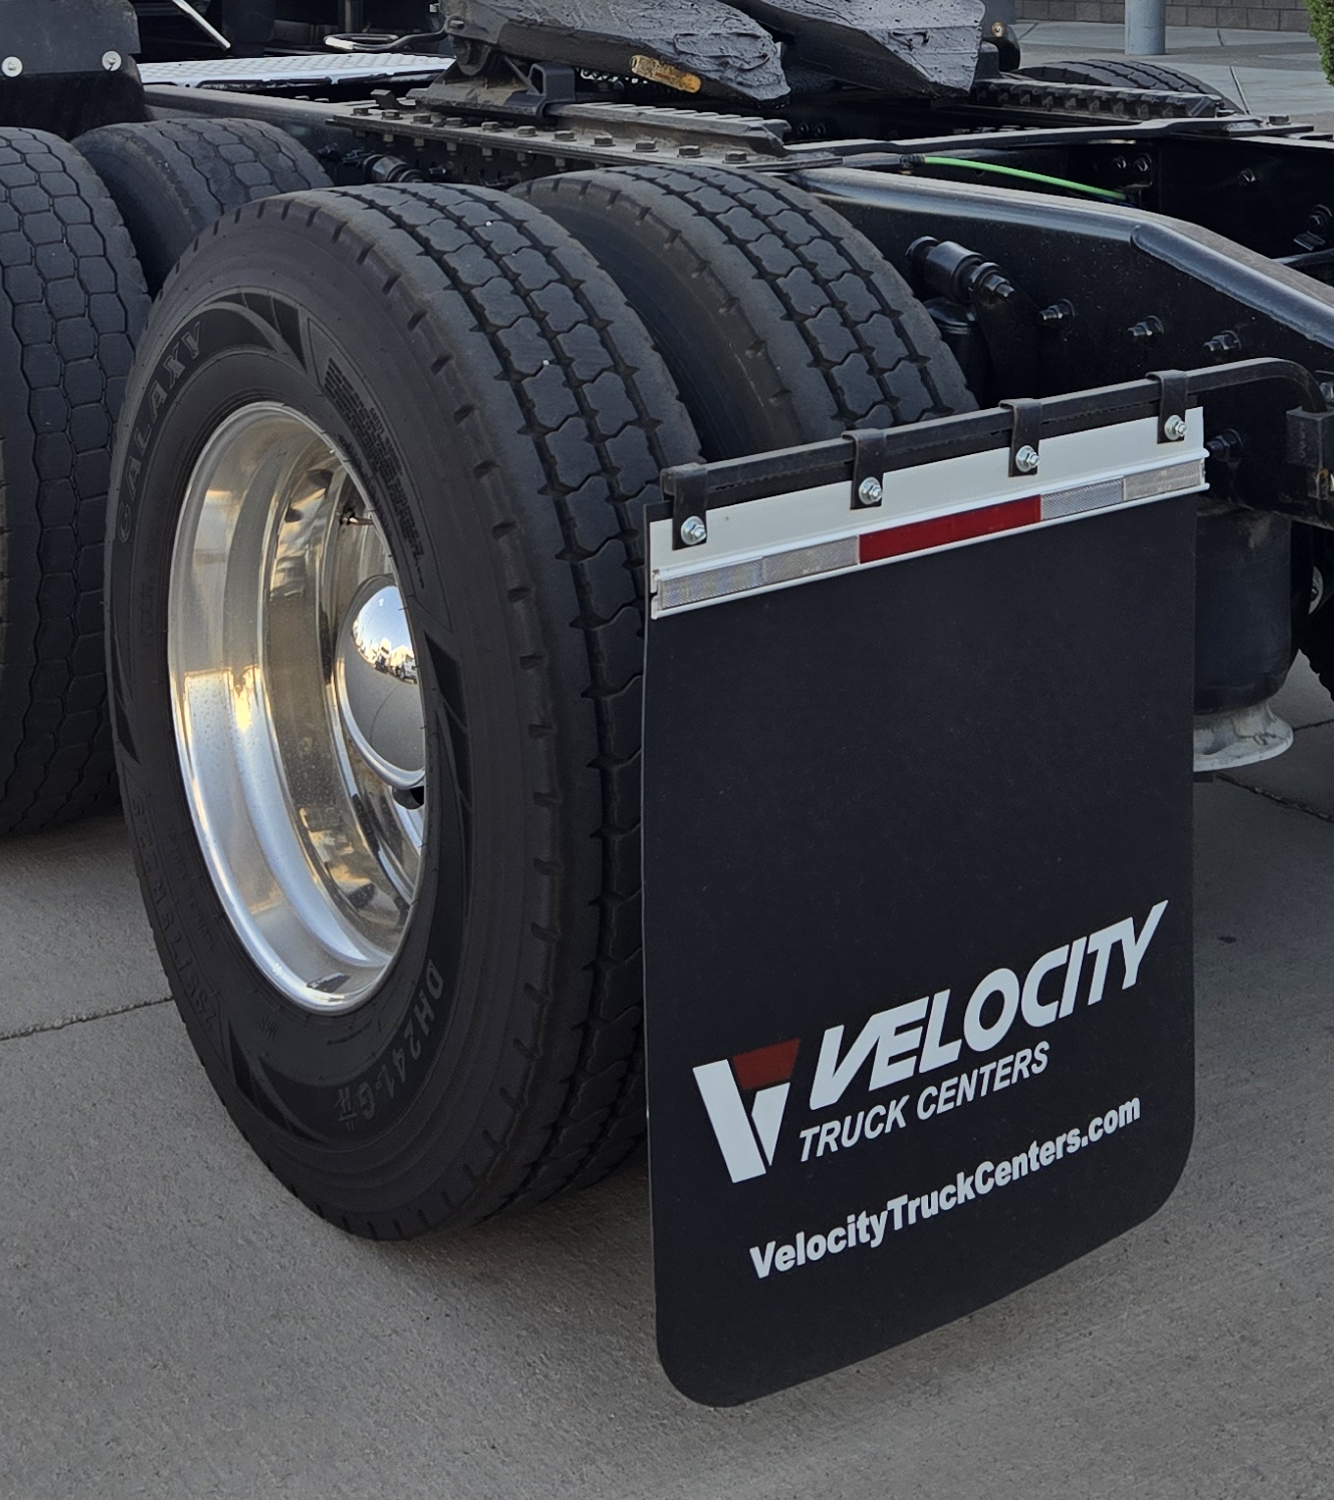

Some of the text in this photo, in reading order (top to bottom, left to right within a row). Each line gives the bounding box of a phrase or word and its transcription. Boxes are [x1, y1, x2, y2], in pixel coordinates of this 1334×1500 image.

[119, 321, 200, 543] GALAXY
[799, 1040, 1050, 1162] TRUCK CENTERS
[809, 899, 1169, 1111] VELOCITY
[749, 1097, 1141, 1279] VelocityTruckCenters.com
